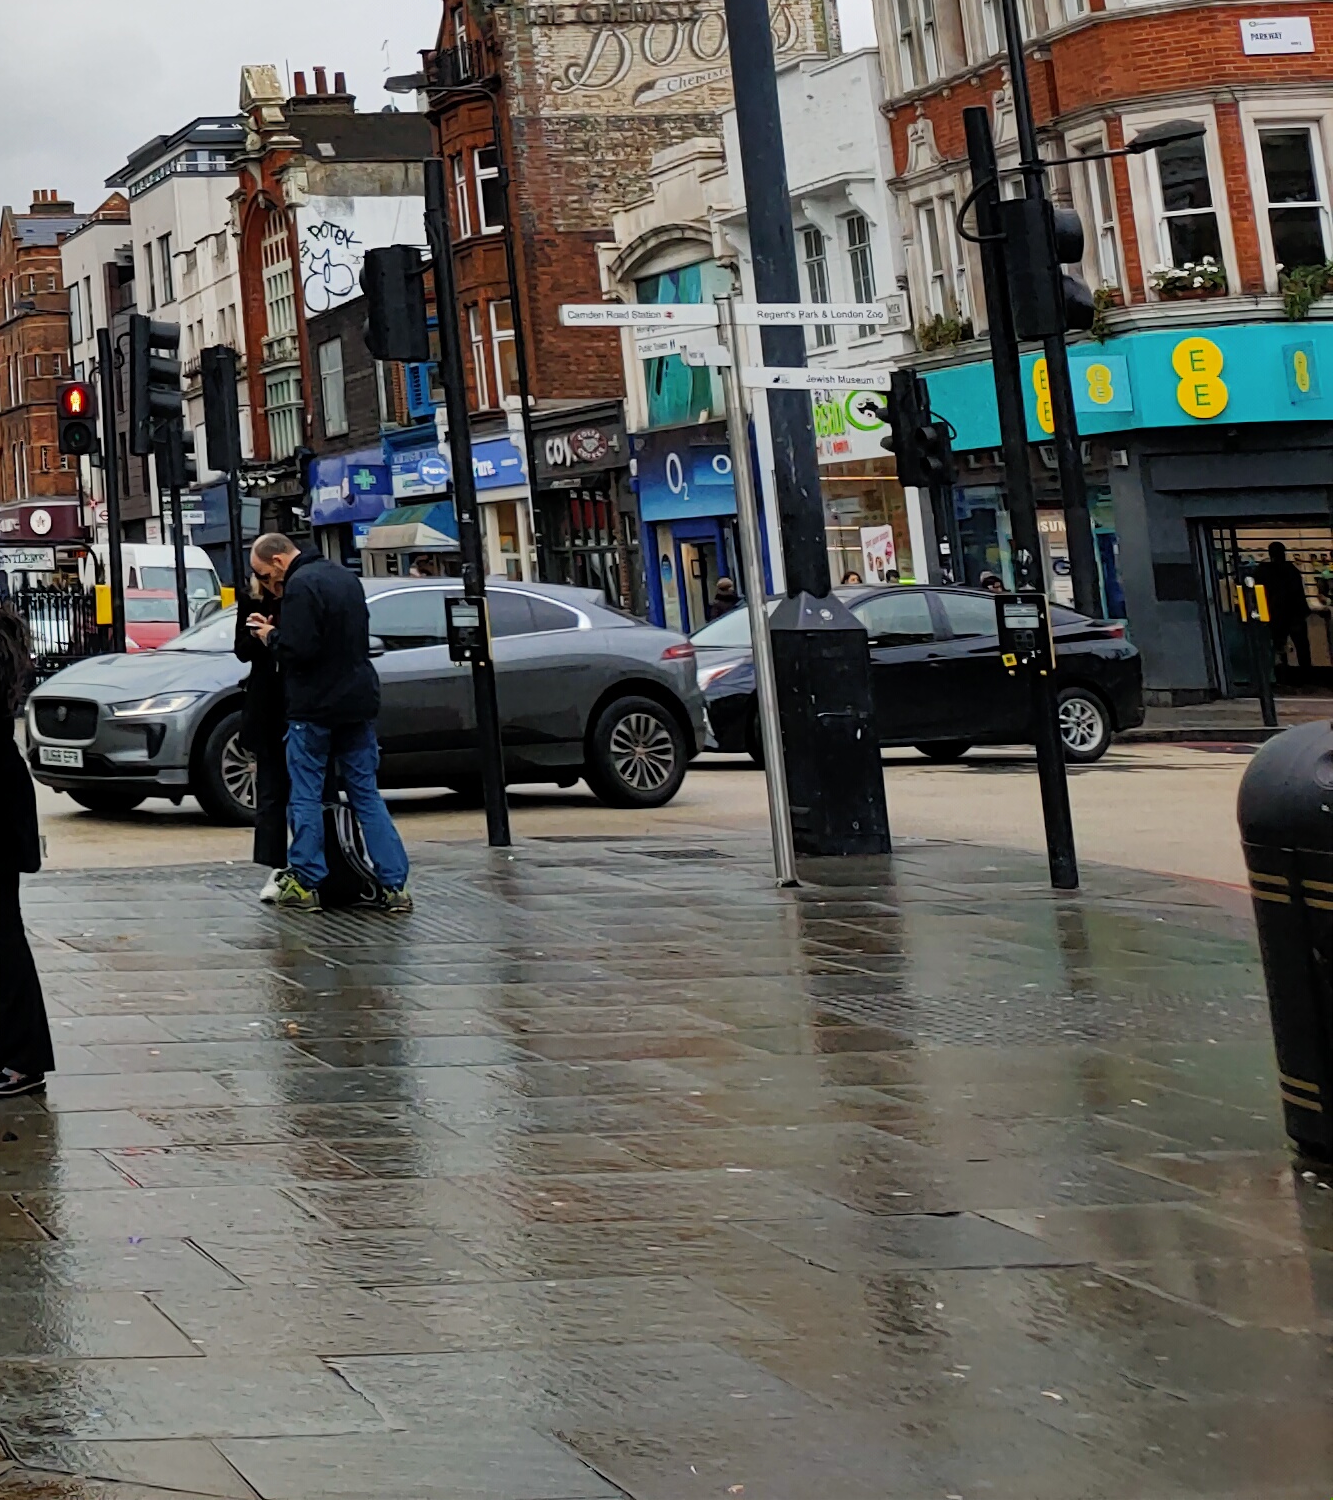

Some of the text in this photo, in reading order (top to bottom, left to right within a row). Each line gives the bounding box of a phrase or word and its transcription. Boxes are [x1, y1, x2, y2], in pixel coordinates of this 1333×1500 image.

[1250, 32, 1282, 41] PARKWAY
[567, 309, 662, 320] Camden Road Station
[757, 309, 884, 321] Regent's Park & London Zoo
[806, 374, 874, 385] Jewish Museum
